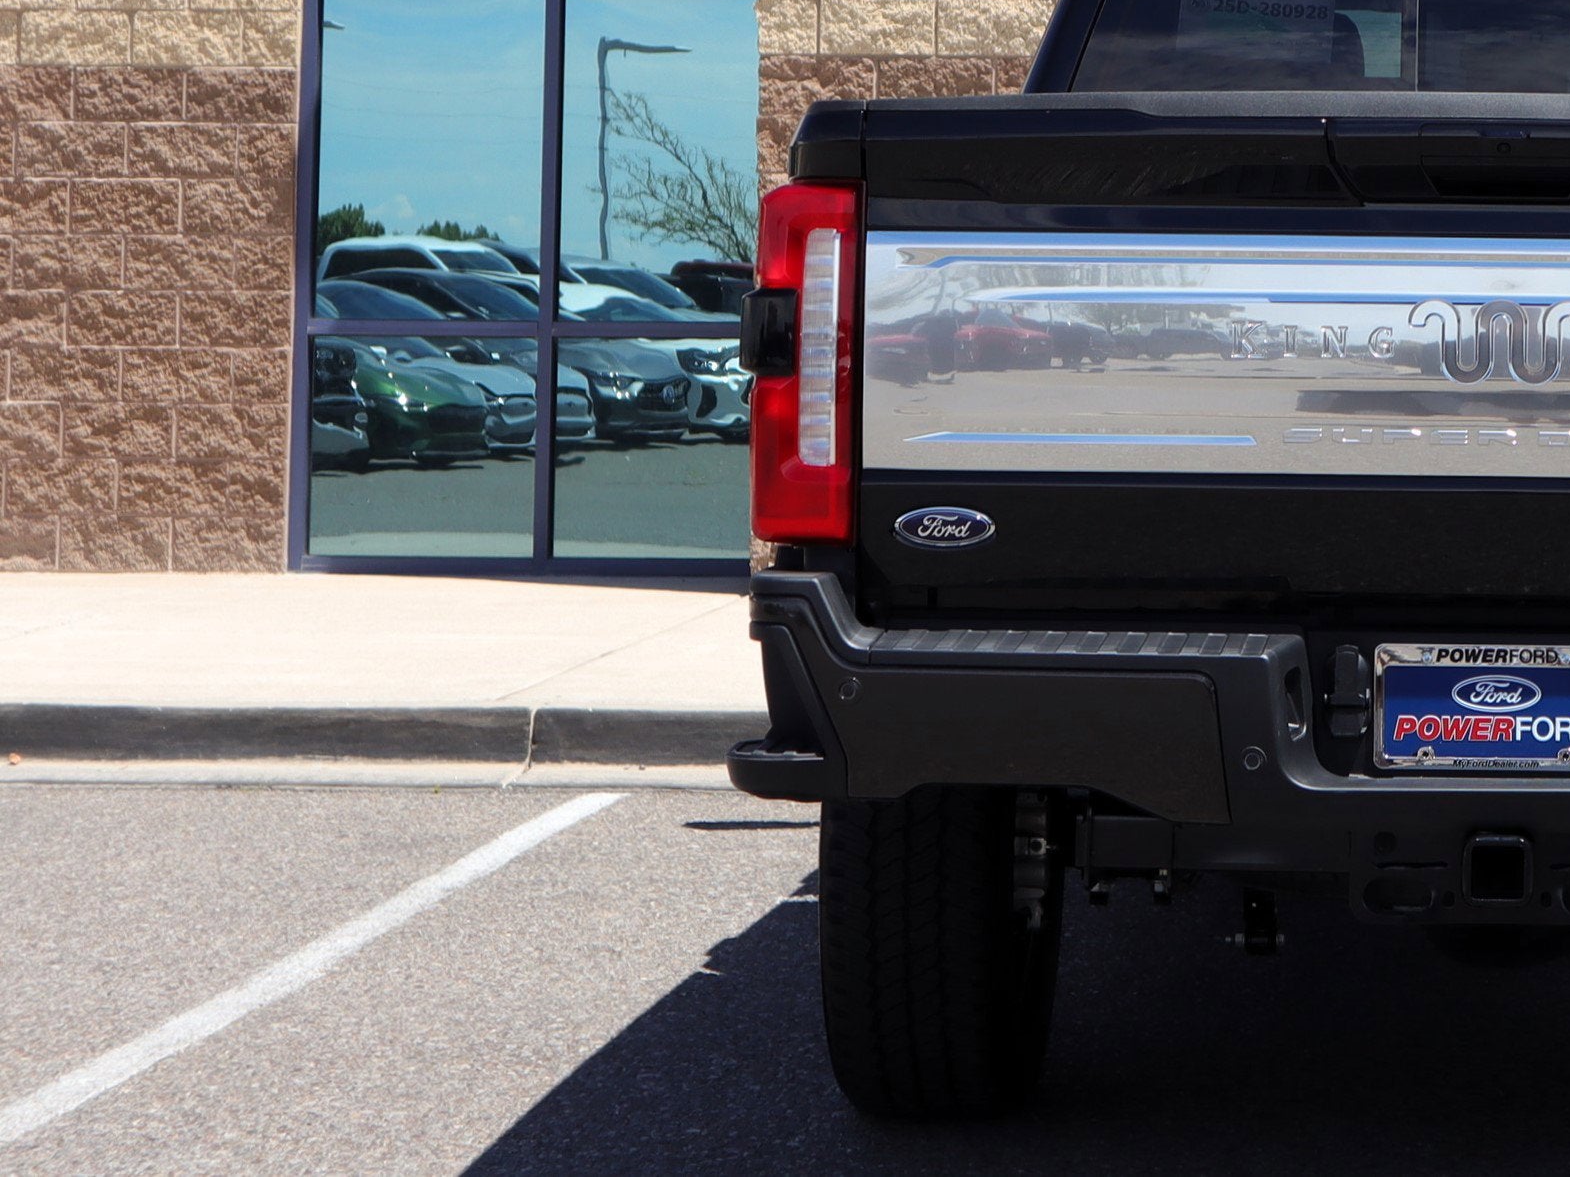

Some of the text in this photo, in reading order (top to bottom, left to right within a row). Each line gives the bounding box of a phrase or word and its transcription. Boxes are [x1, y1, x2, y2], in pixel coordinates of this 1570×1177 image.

[1231, 321, 1397, 359] KING
[1282, 427, 1518, 447] SUPER
[917, 514, 970, 538] Ford
[1436, 648, 1558, 664] POWERFORD
[1470, 681, 1522, 704] Ford
[1453, 758, 1540, 770] MyFordDealer.com
